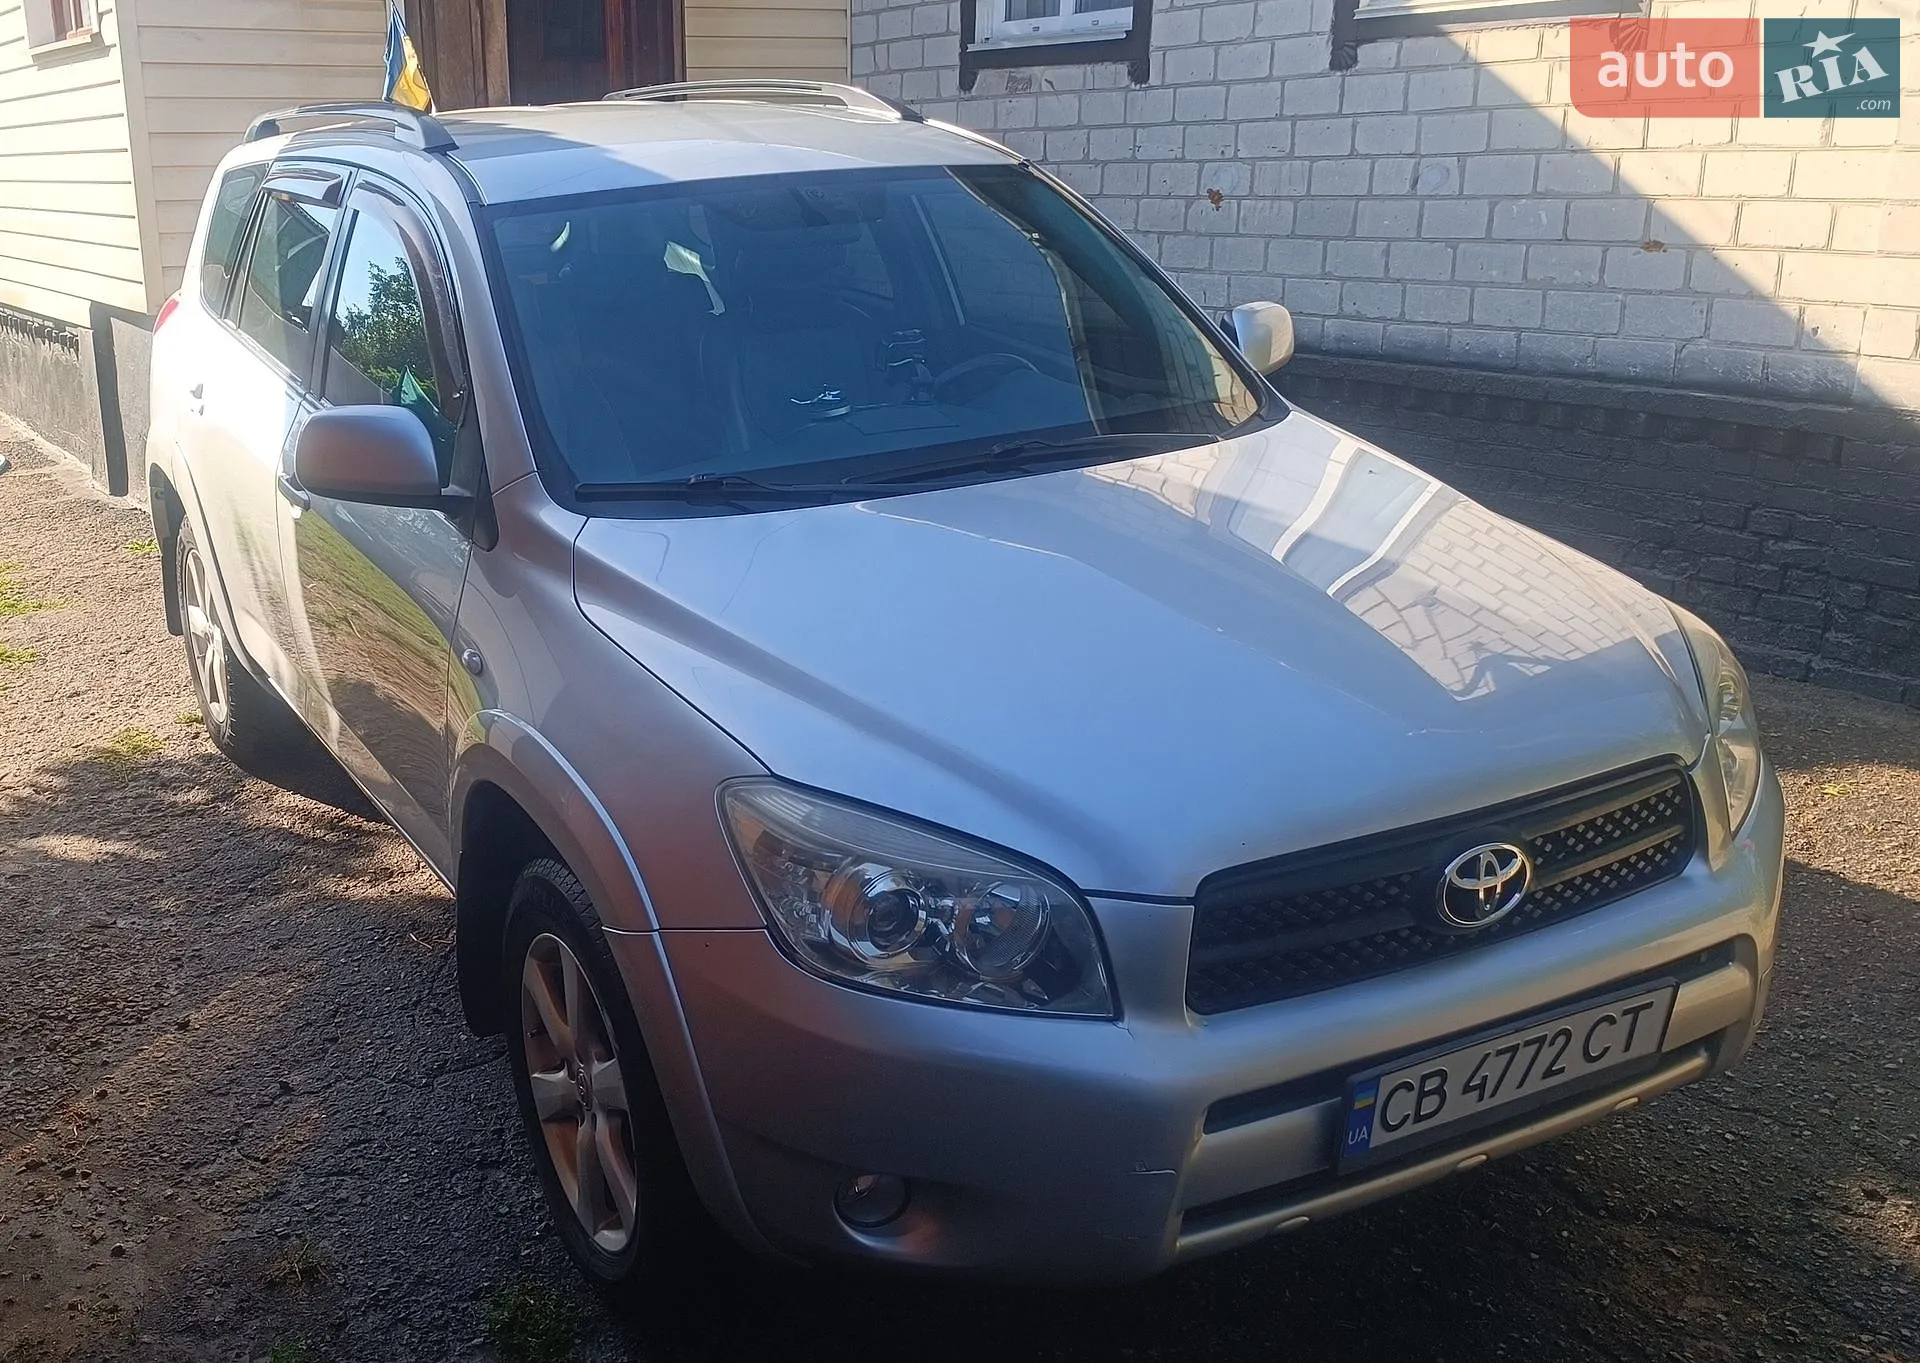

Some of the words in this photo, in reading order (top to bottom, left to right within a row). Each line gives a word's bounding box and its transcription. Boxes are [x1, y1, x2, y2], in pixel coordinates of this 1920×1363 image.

[1380, 1066, 1449, 1133] CB
[1461, 1026, 1574, 1102] 4772
[1582, 1001, 1654, 1063] CT
[1347, 1125, 1369, 1145] UA
